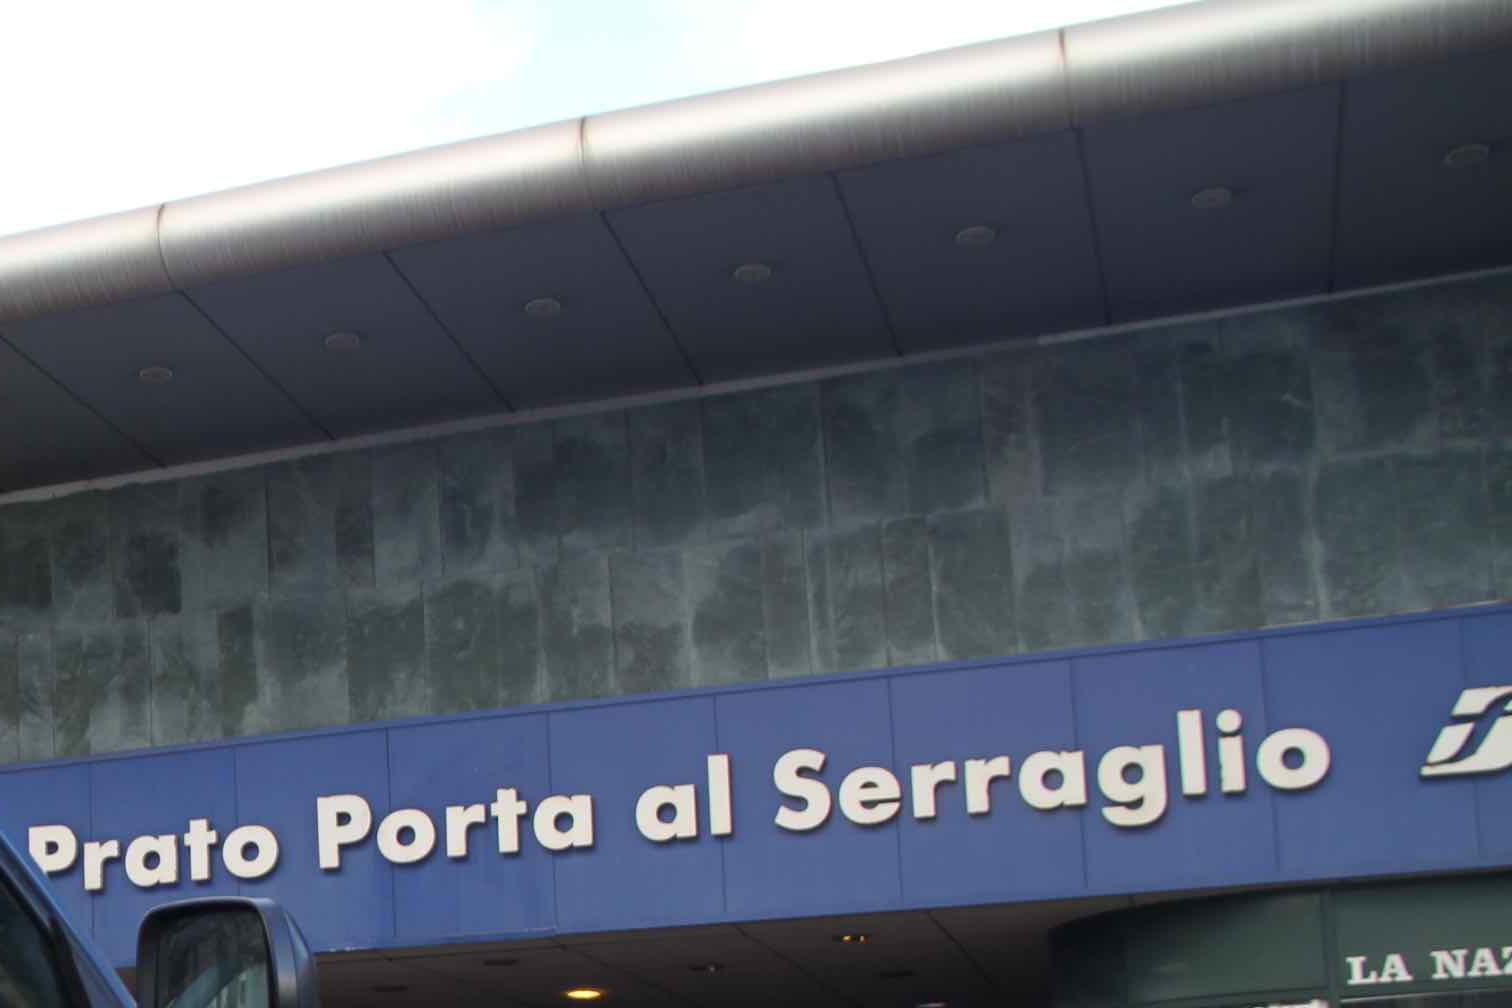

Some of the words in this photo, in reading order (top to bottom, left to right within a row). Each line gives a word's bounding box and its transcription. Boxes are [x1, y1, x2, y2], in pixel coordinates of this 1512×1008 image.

[27, 818, 280, 891] Prato
[316, 787, 594, 871] Porta
[634, 753, 733, 842] al
[772, 708, 1331, 831] Serraglio
[1345, 953, 1414, 985] LA
